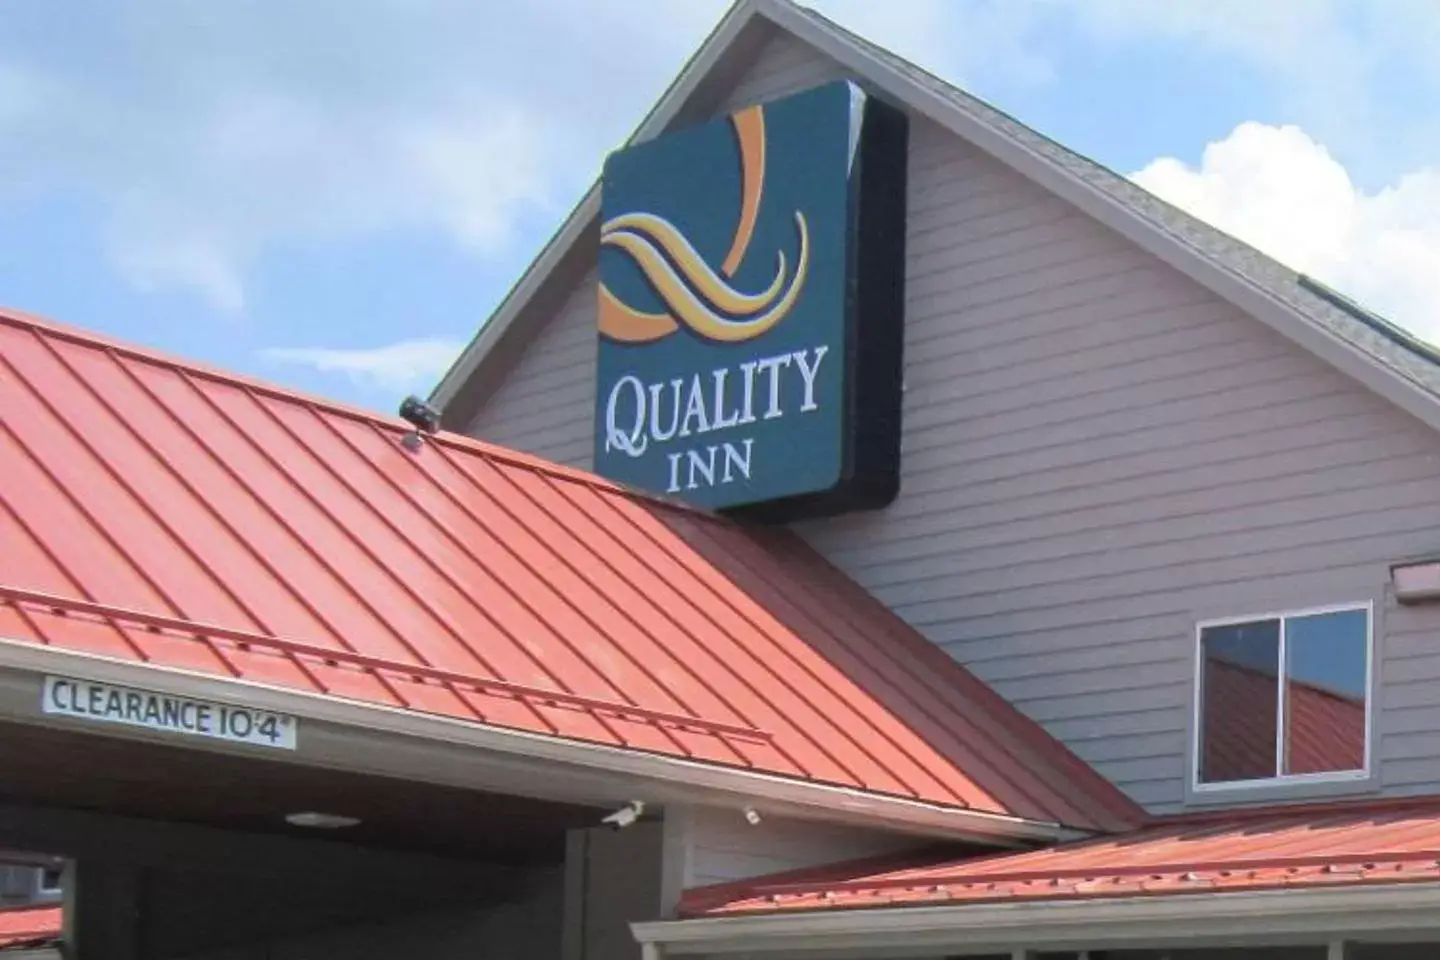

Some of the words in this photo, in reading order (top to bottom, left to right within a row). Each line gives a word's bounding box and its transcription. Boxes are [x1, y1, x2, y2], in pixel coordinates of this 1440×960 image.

[605, 346, 828, 456] QUALITY
[667, 440, 754, 492] INN
[51, 681, 210, 732] CLEARANCE
